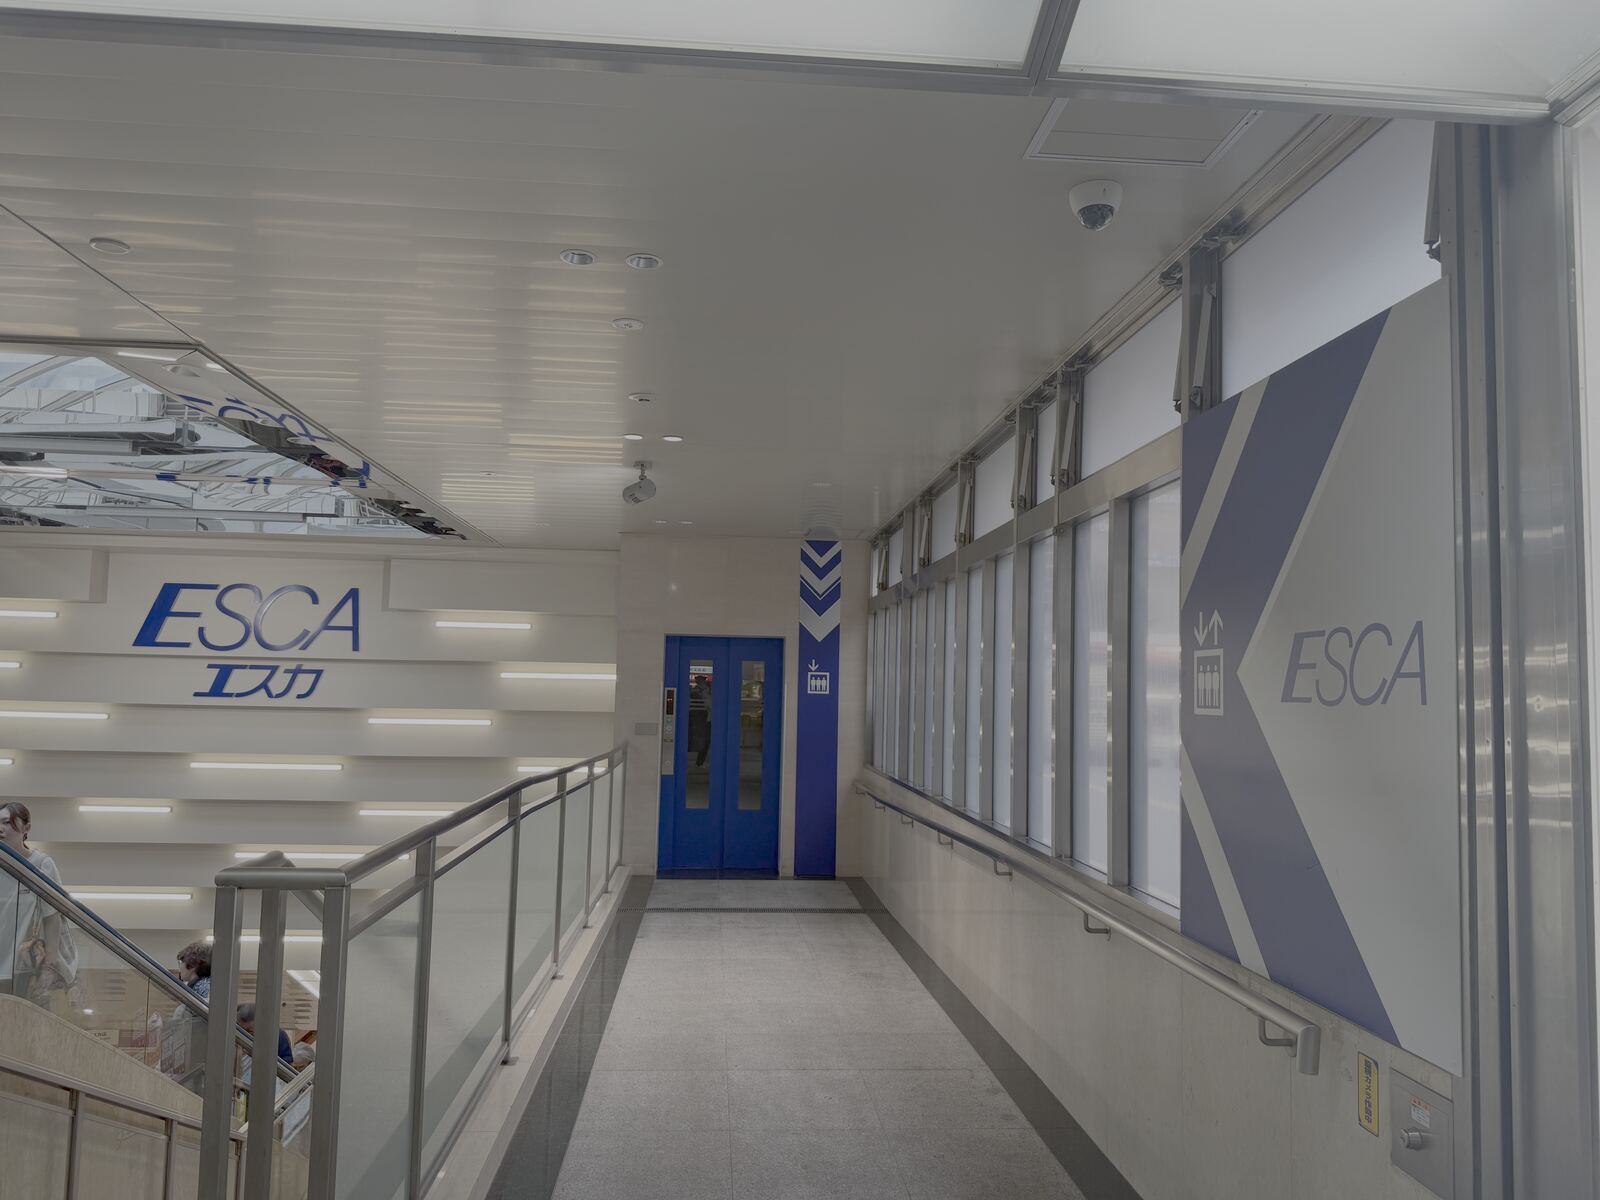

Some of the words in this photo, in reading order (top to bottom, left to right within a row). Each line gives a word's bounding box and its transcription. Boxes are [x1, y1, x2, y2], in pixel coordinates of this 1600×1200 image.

[132, 582, 360, 651] ESCA
[193, 663, 324, 699] エスカ
[1280, 620, 1427, 707] ESCA
